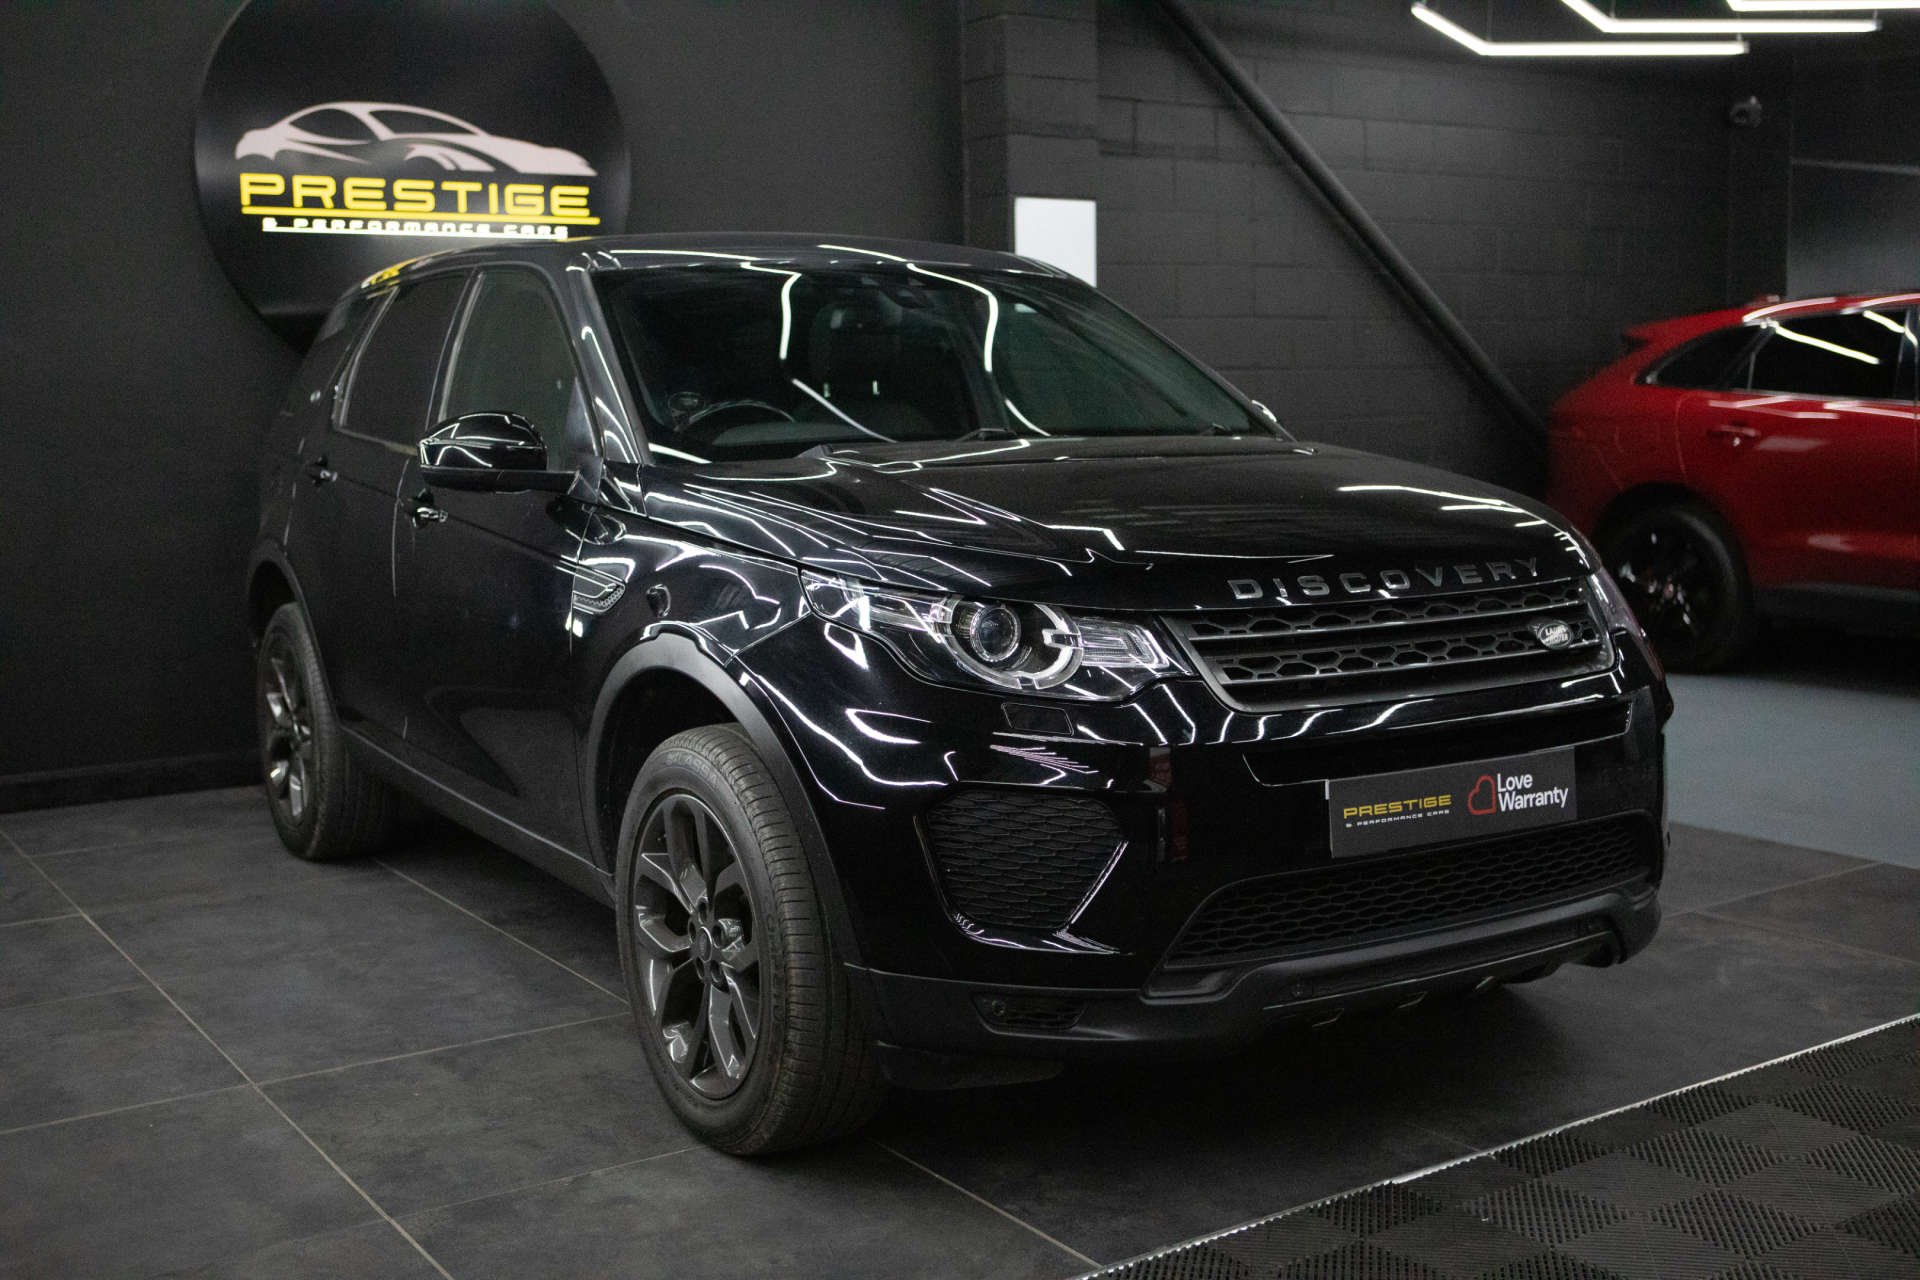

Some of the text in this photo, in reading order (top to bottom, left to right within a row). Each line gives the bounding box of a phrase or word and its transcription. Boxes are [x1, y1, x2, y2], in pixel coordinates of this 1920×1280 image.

[240, 172, 590, 216] PRESTIGE
[294, 218, 491, 236] PERFORMANCE
[503, 223, 568, 239] CARS
[1227, 556, 1538, 599] DISCOVERY
[1497, 773, 1533, 792] Love
[1343, 794, 1452, 819] PRESTIGE
[1498, 787, 1568, 812] Warranty
[1357, 813, 1423, 826] PERFORMANCE
[1427, 808, 1450, 817] CARS
